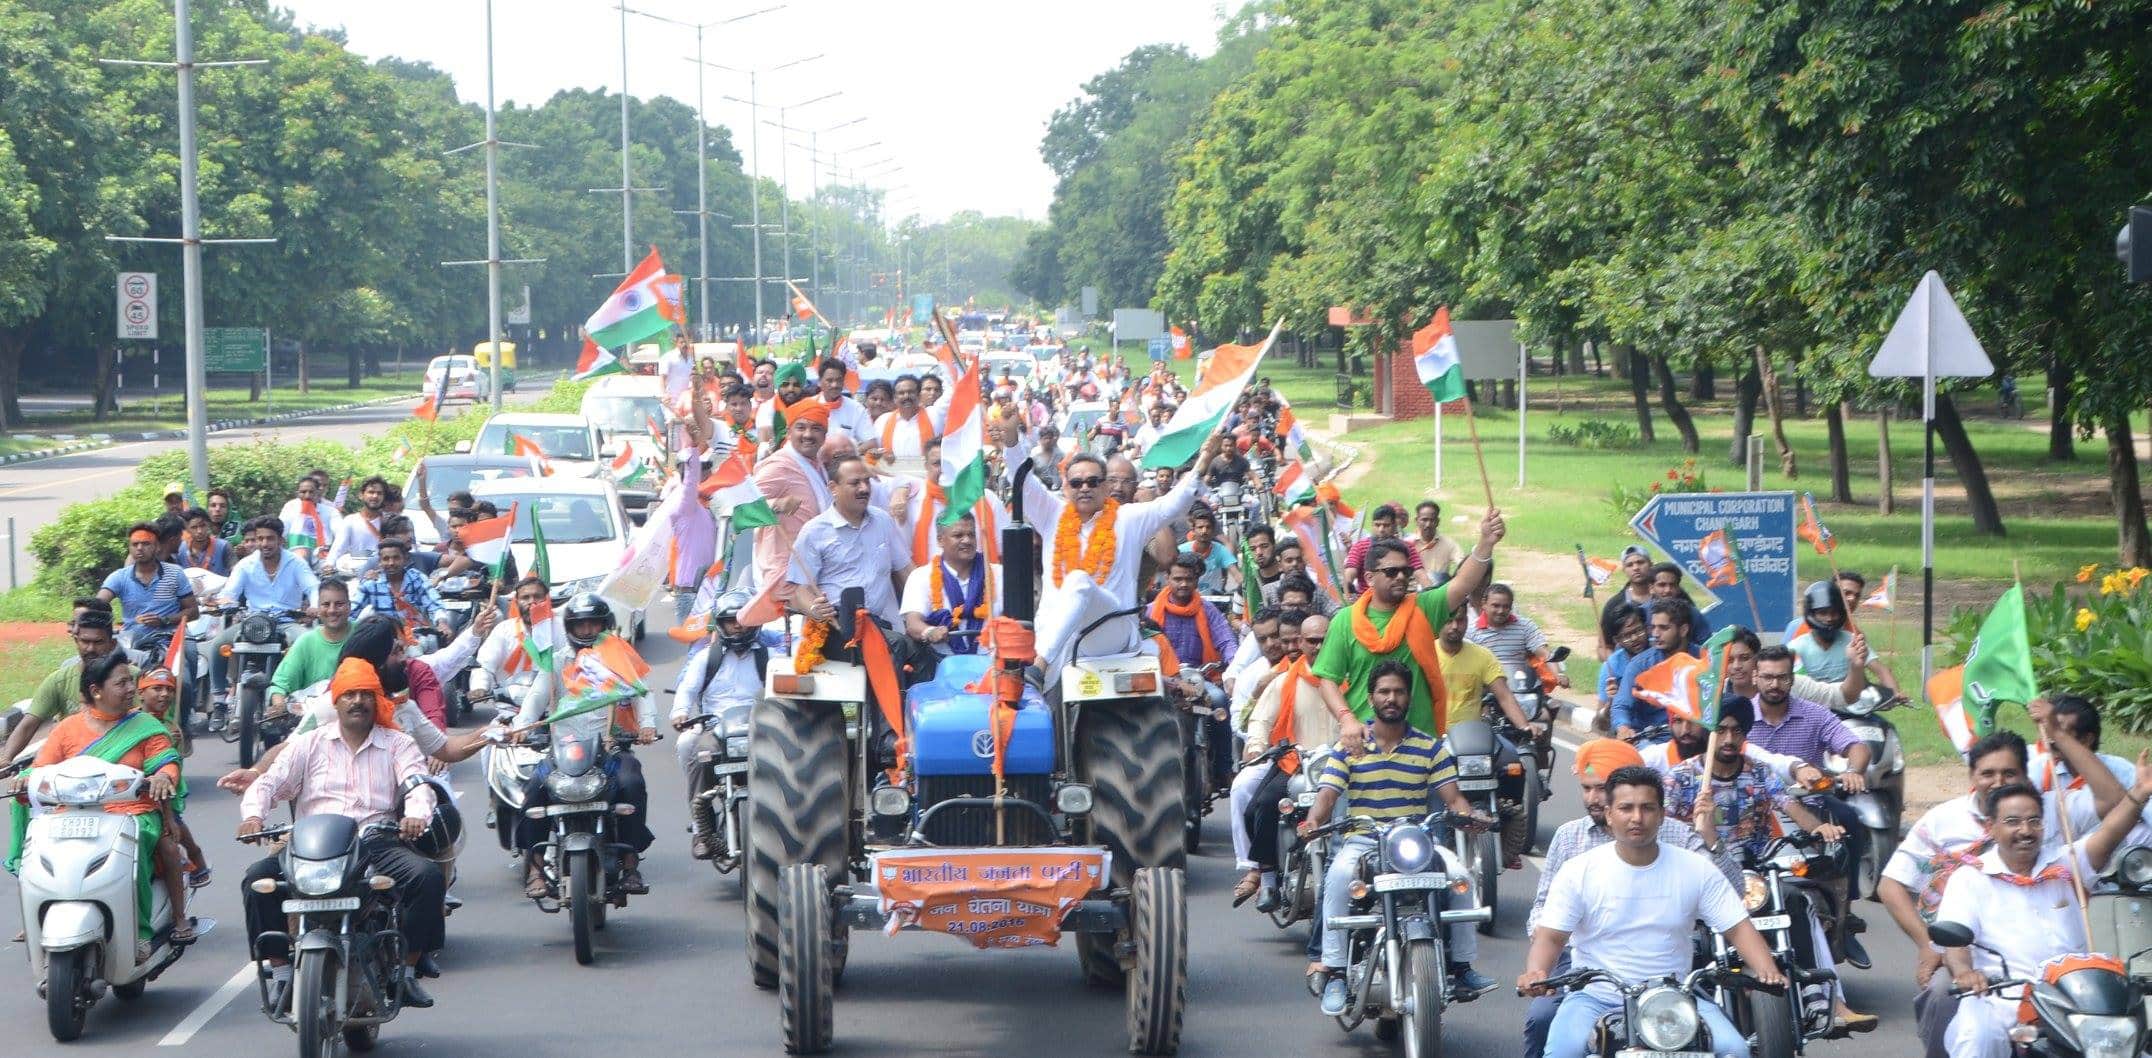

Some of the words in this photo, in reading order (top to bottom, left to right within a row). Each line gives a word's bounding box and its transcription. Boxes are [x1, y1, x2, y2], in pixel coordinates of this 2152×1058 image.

[1665, 500, 1716, 516] MUNICIPAL
[1718, 498, 1785, 514] CORPORATION
[902, 863, 968, 883] भारतीय
[977, 864, 1032, 881] जनता
[928, 903, 959, 917] जन
[967, 896, 1012, 915] चेतना
